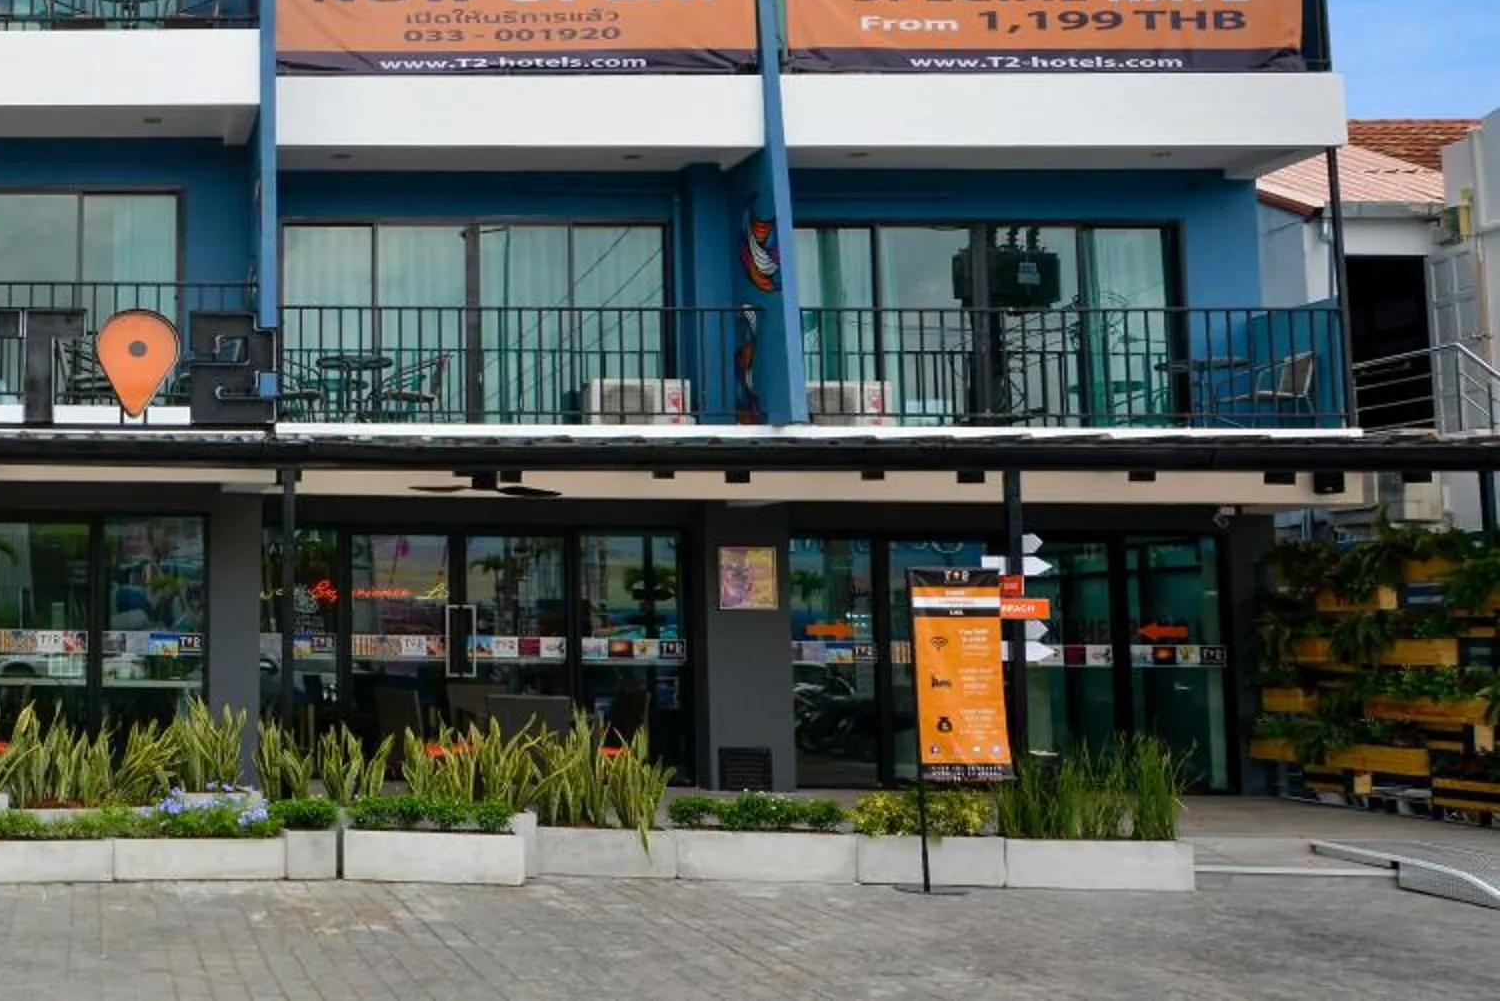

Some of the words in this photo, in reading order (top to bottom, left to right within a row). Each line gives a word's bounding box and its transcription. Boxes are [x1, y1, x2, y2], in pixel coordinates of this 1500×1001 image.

[405, 8, 620, 25] เปิดให้บริการแล้ว
[860, 14, 961, 32] From
[977, 9, 1125, 34] 1,199
[1132, 9, 1247, 31] THB
[404, 29, 465, 42] 033
[493, 27, 622, 42] 001920
[378, 55, 648, 70] www.T2-hotels.com
[909, 55, 1184, 69] www.T2-hotels.com
